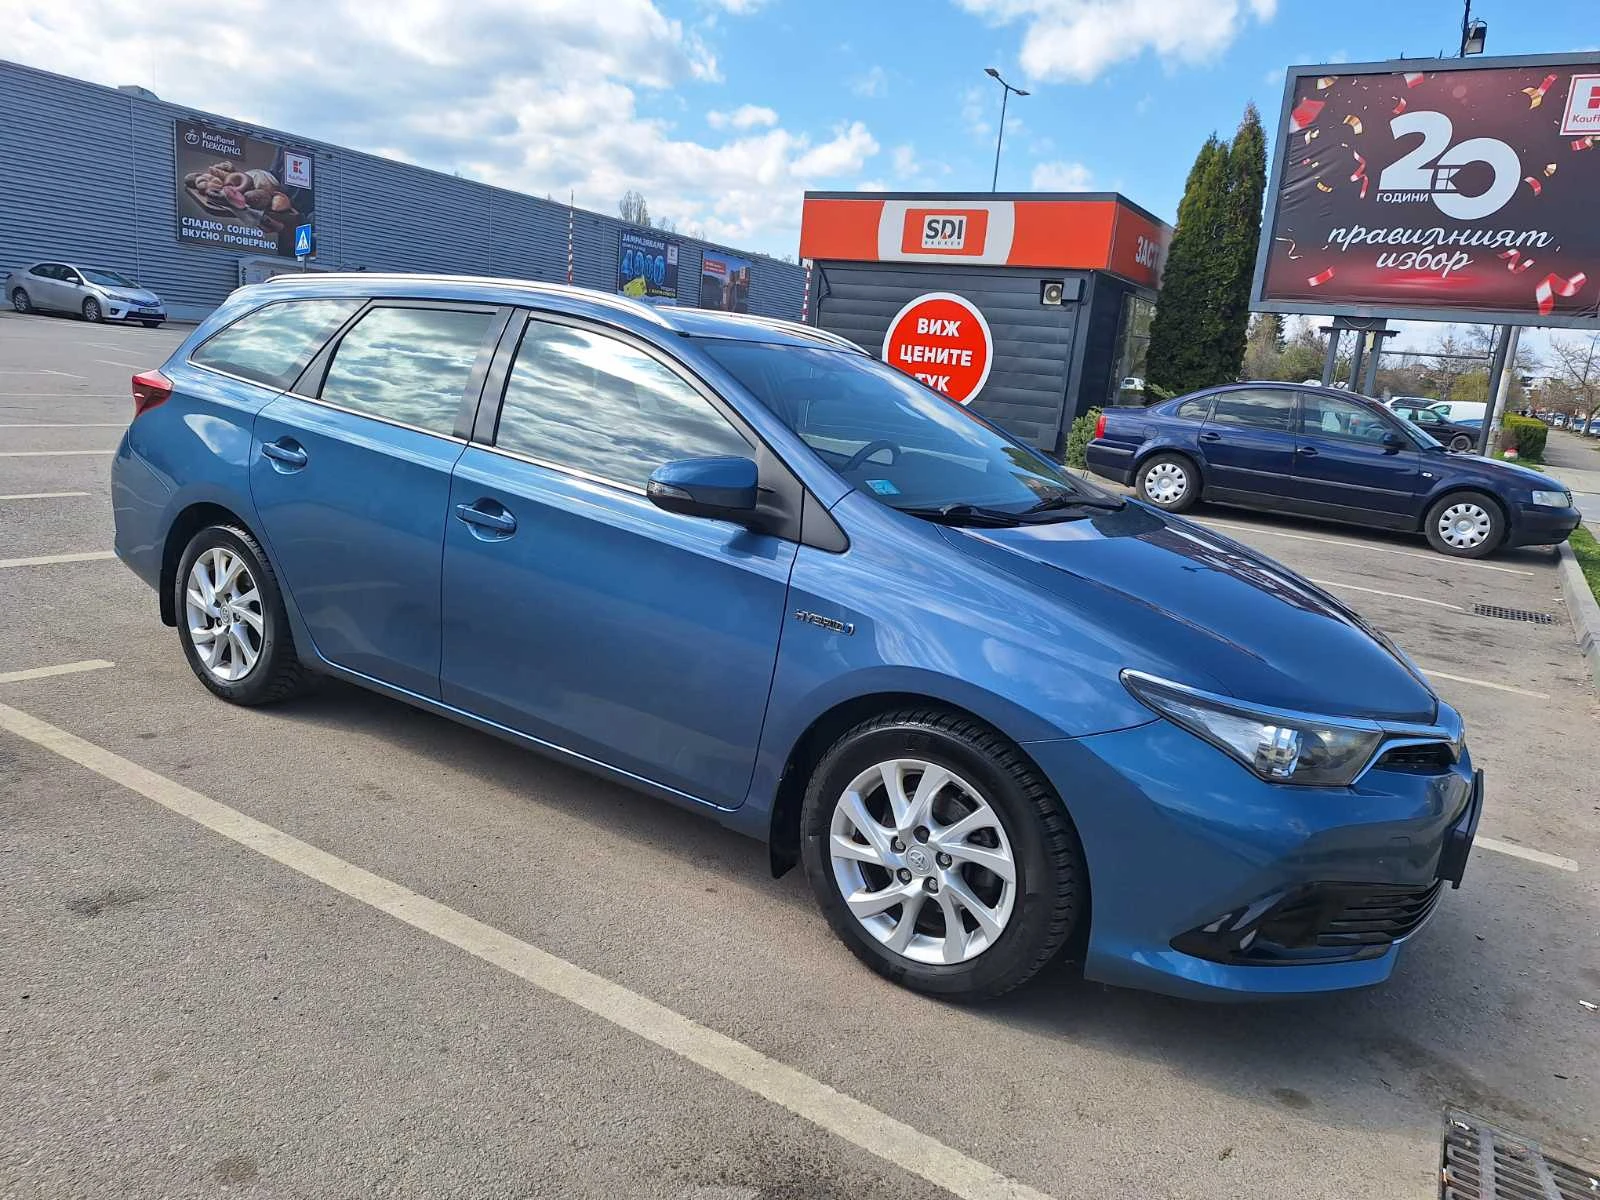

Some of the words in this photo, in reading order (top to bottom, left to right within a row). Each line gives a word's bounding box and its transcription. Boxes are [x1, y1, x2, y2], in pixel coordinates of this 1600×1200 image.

[1573, 114, 1600, 123] Kauf
[202, 131, 235, 146] Kaufland
[202, 140, 241, 155] пекарна
[182, 217, 225, 232] СЛАДКО.
[227, 224, 265, 238] СОЛЕНО.
[926, 219, 964, 239] SDI
[1328, 224, 1554, 251] правилният
[182, 228, 222, 241] ВКУСНО.
[224, 234, 278, 250] ПРОВЕРЕНО.
[1376, 244, 1474, 278] избор
[917, 318, 961, 337] ВИЖ
[900, 344, 972, 367] ЦЕНИТЕ
